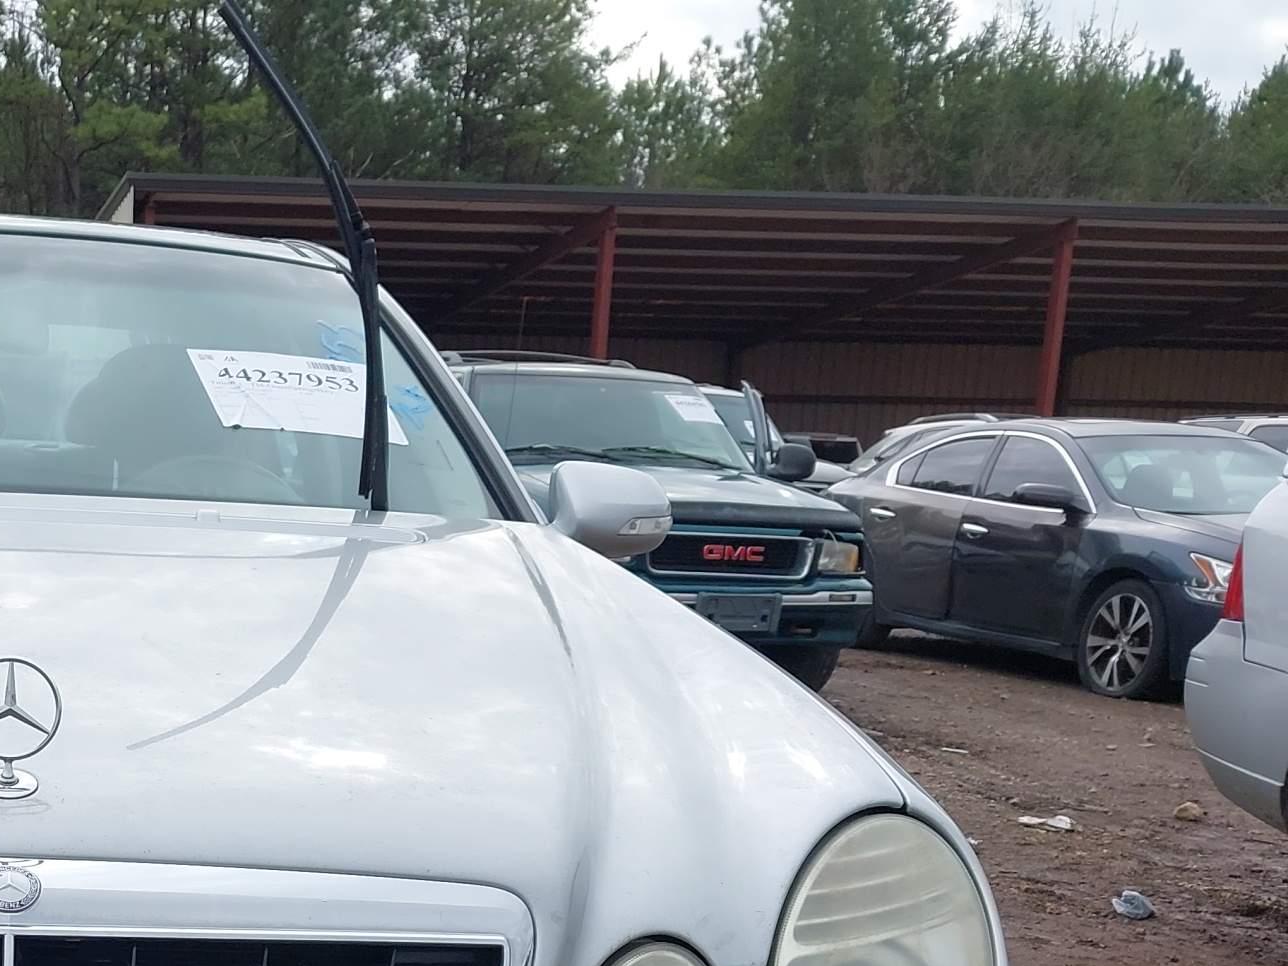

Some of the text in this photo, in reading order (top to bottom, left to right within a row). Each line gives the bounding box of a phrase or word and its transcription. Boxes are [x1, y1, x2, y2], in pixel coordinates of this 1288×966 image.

[217, 366, 360, 393] 44237953
[703, 544, 765, 561] GMC
[0, 901, 20, 909] BENZ
